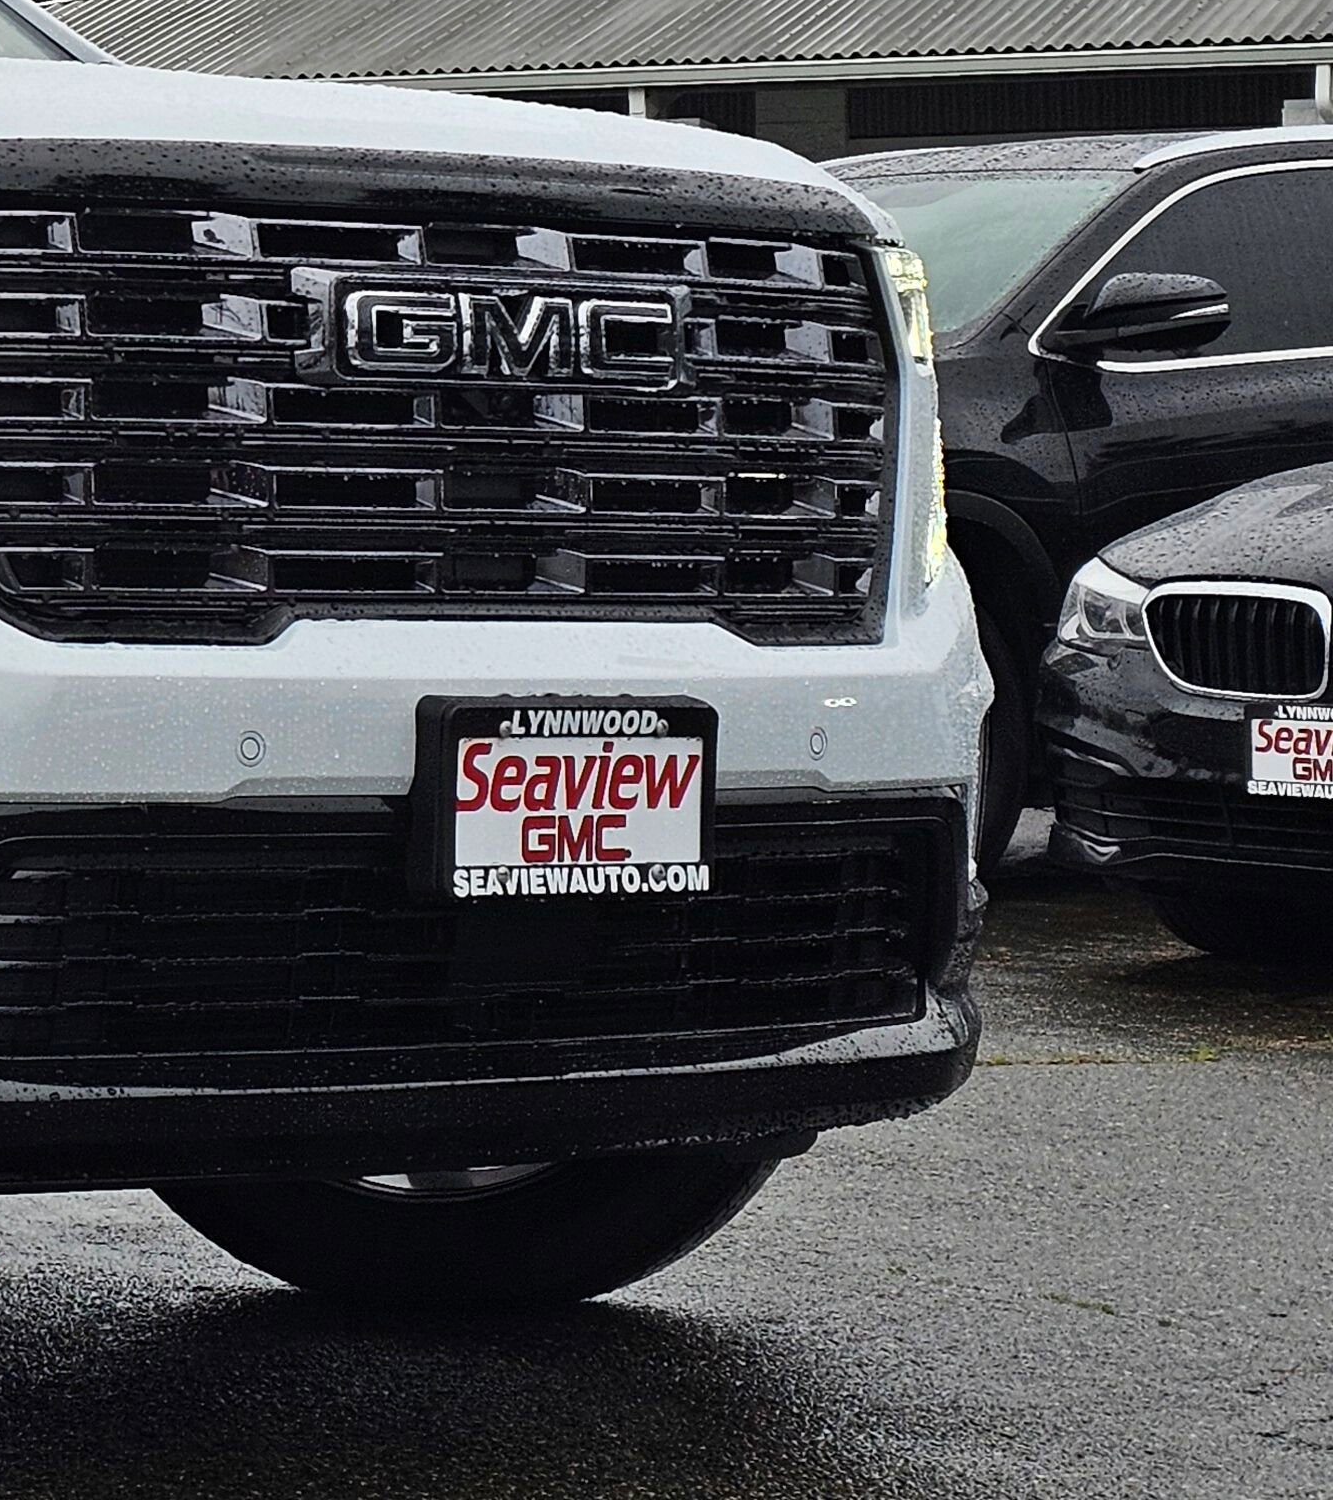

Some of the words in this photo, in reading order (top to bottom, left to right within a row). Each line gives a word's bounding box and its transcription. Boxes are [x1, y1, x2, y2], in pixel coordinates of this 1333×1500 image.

[345, 290, 675, 391] GMC
[510, 709, 660, 736] LYNNWOOD
[1277, 704, 1333, 721] LYNNW
[1255, 719, 1333, 757] Seav
[454, 741, 700, 812] Seaview
[521, 814, 628, 863] GMC
[452, 864, 710, 898] SEAVIEWAUTO.COM
